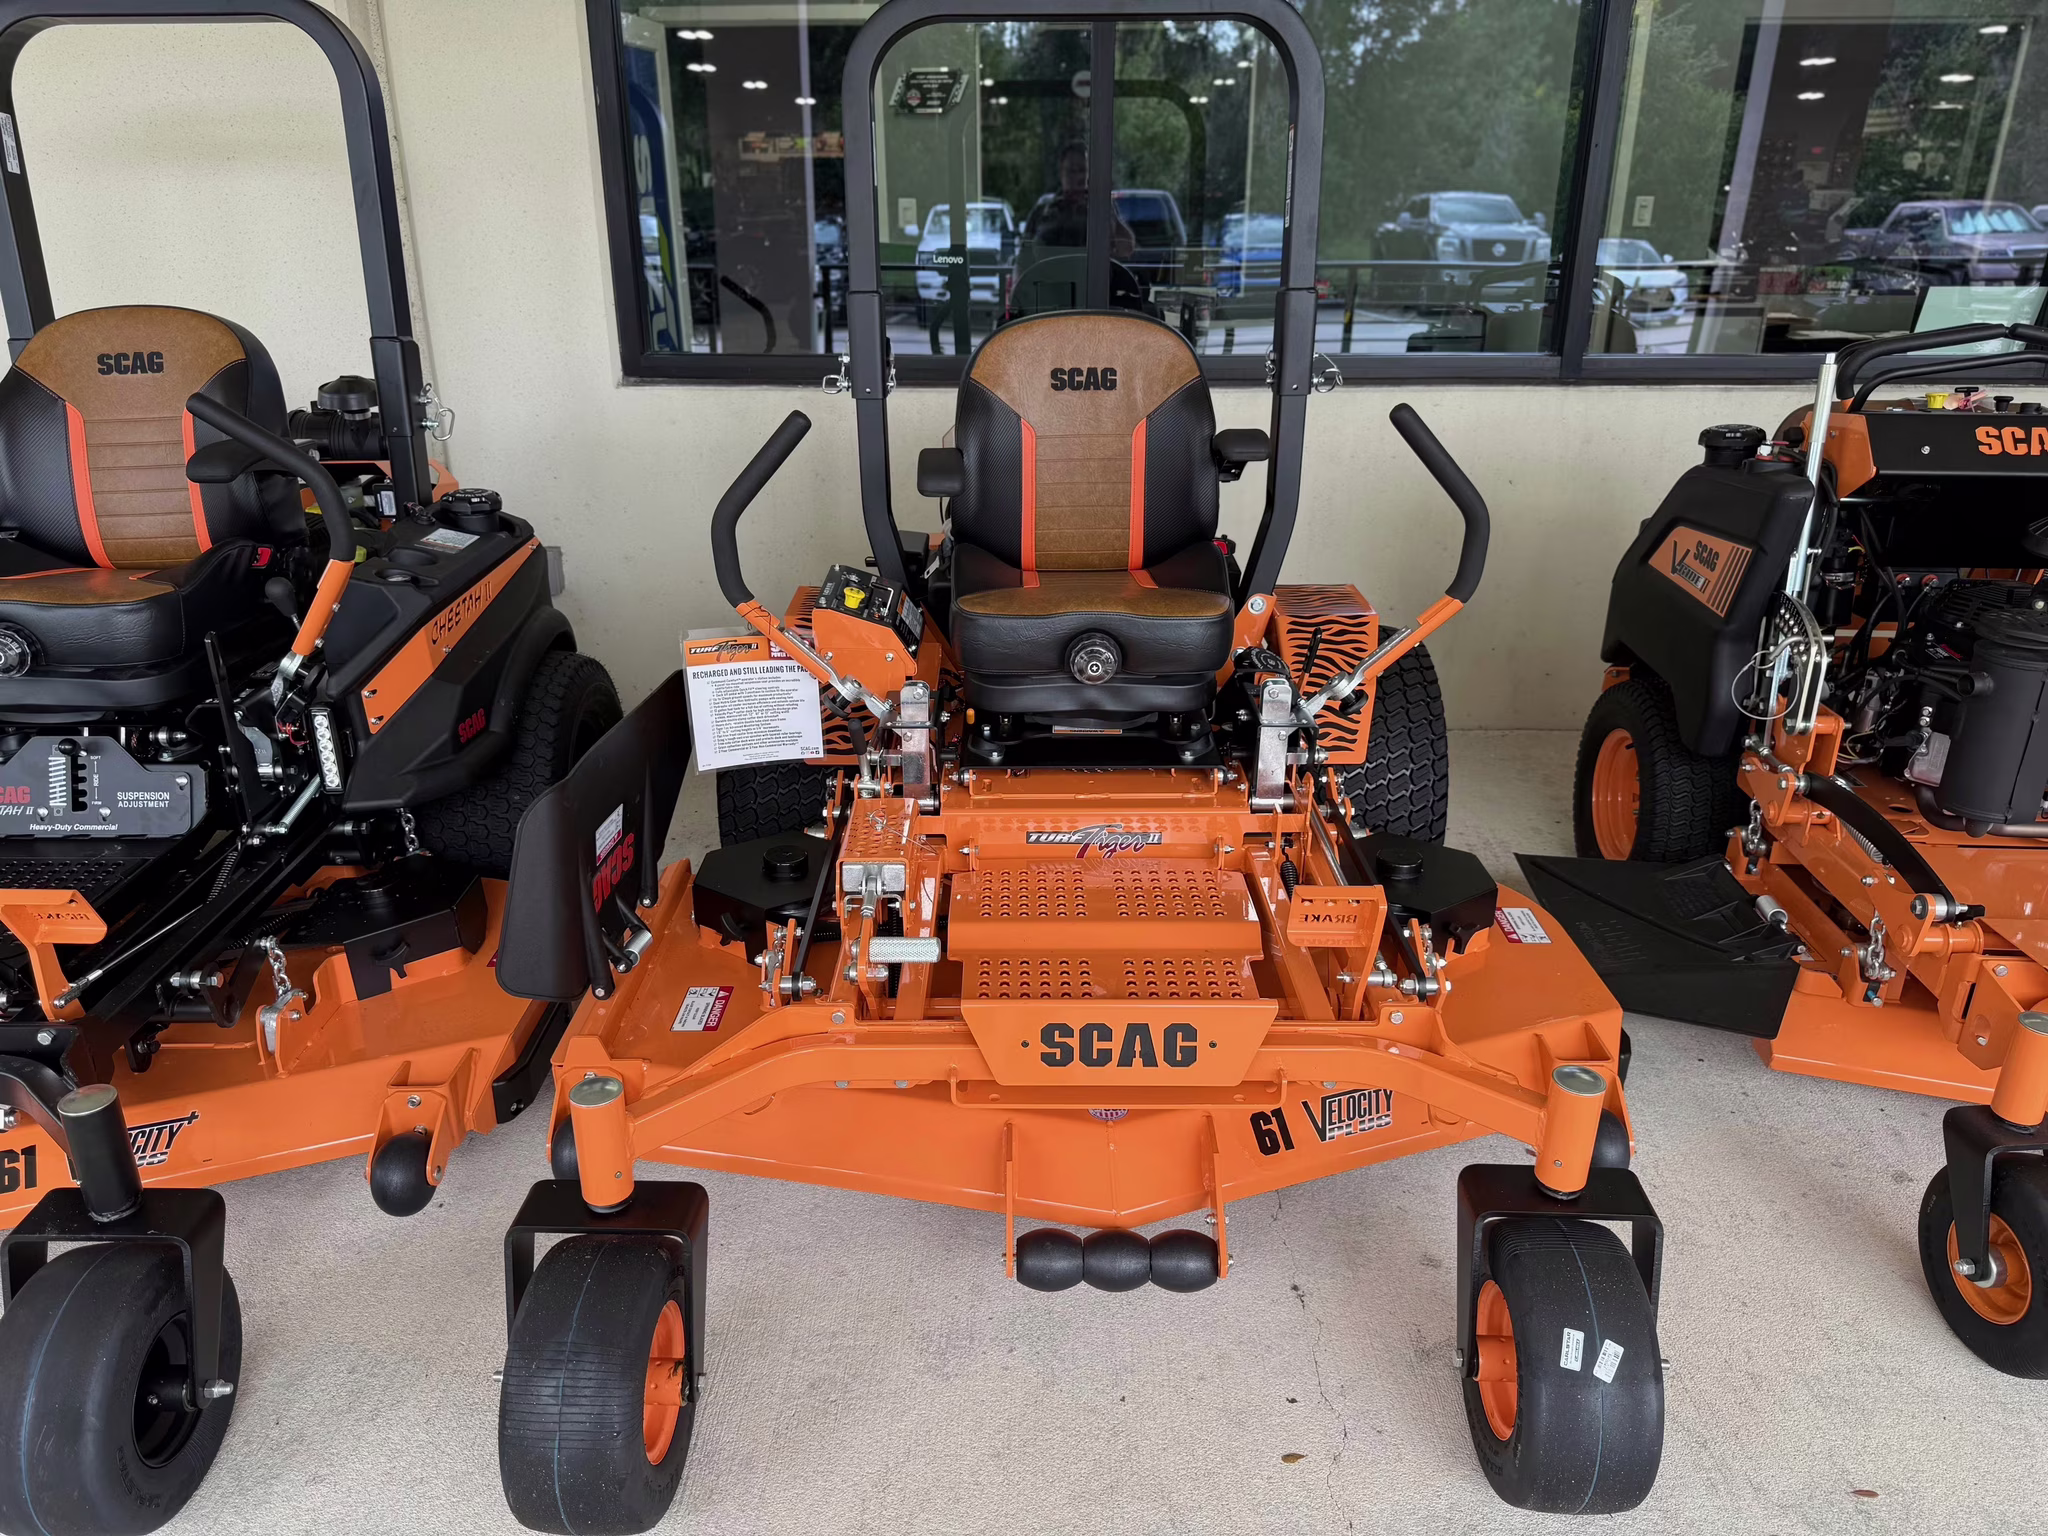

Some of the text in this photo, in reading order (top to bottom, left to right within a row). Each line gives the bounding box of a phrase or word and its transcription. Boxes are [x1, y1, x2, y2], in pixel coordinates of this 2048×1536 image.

[933, 254, 964, 264] Lenovo
[97, 351, 164, 376] SCAG
[1050, 367, 1117, 391] SCAG
[1975, 426, 2048, 456] SCA
[1693, 540, 1720, 573] SCAG
[432, 584, 484, 645] CHEETAH
[690, 646, 719, 654] TURF
[713, 640, 750, 662] Tiger
[692, 668, 728, 679] RECHARGED
[730, 668, 742, 676] AND
[742, 667, 759, 675] STILL
[458, 708, 485, 743] SCAG
[117, 792, 170, 800] SUSPENSION
[1028, 824, 1161, 858] TURF Tiger II
[592, 832, 634, 913] SCAG
[706, 1000, 726, 1026] DANGER
[1040, 1023, 1198, 1067] SCAG
[1250, 1106, 1295, 1156] 61
[1301, 1089, 1394, 1142] VELOCITY
[1328, 1114, 1392, 1140] PLUS
[0, 1144, 37, 1194] 61
